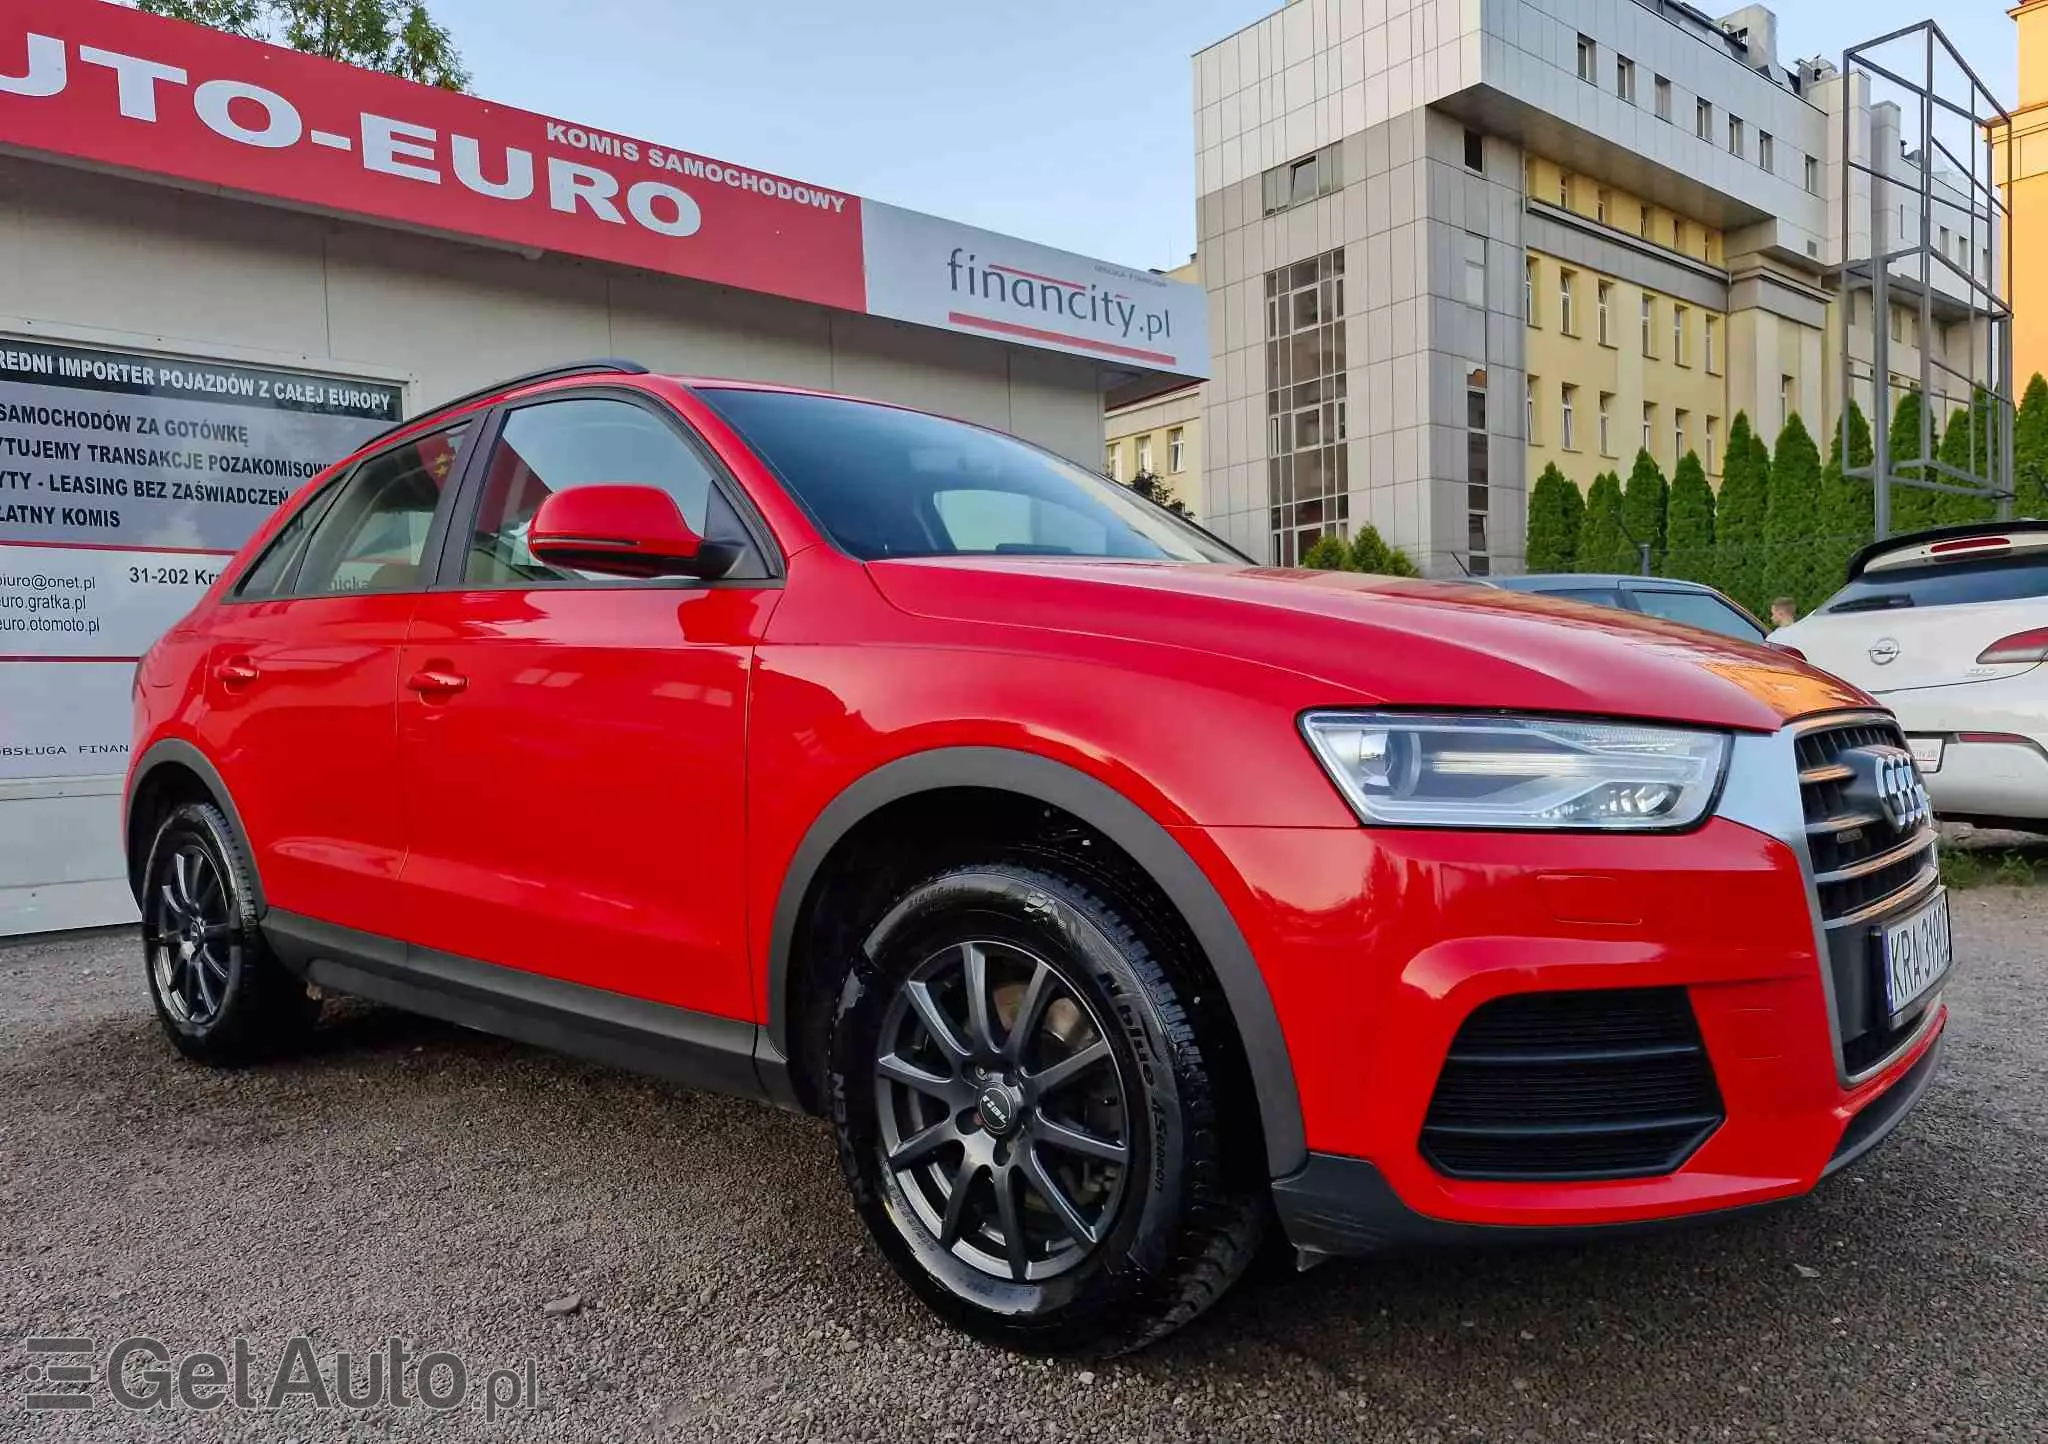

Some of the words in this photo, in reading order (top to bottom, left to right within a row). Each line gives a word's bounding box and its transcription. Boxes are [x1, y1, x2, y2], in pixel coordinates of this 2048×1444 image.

[0, 32, 701, 238] UTO-EURO
[546, 121, 640, 162] KOMIS
[648, 147, 847, 214] SAMOCHODOWY
[947, 248, 1171, 341] financity.pl
[59, 357, 155, 386] IMPORTER
[159, 368, 255, 397] POJAZDÓW
[258, 380, 270, 399] Z
[274, 383, 324, 404] CAŁEJ
[329, 388, 391, 411] EUROPY
[136, 416, 160, 436] ZA
[165, 419, 249, 447] GOTÓWKĘ
[87, 444, 203, 470] TRANSAKCJE
[208, 455, 331, 479] POZAKOMISOW
[50, 473, 128, 497] LEASING
[134, 479, 168, 499] BEZ
[62, 508, 121, 528] KOMIS
[0, 575, 96, 591] iuro@onet.pl
[129, 567, 188, 585] 31-202
[0, 617, 99, 635] uro.otomoto.pl
[0, 745, 67, 756] BSŁUGA
[1891, 923, 1922, 1002] KRA
